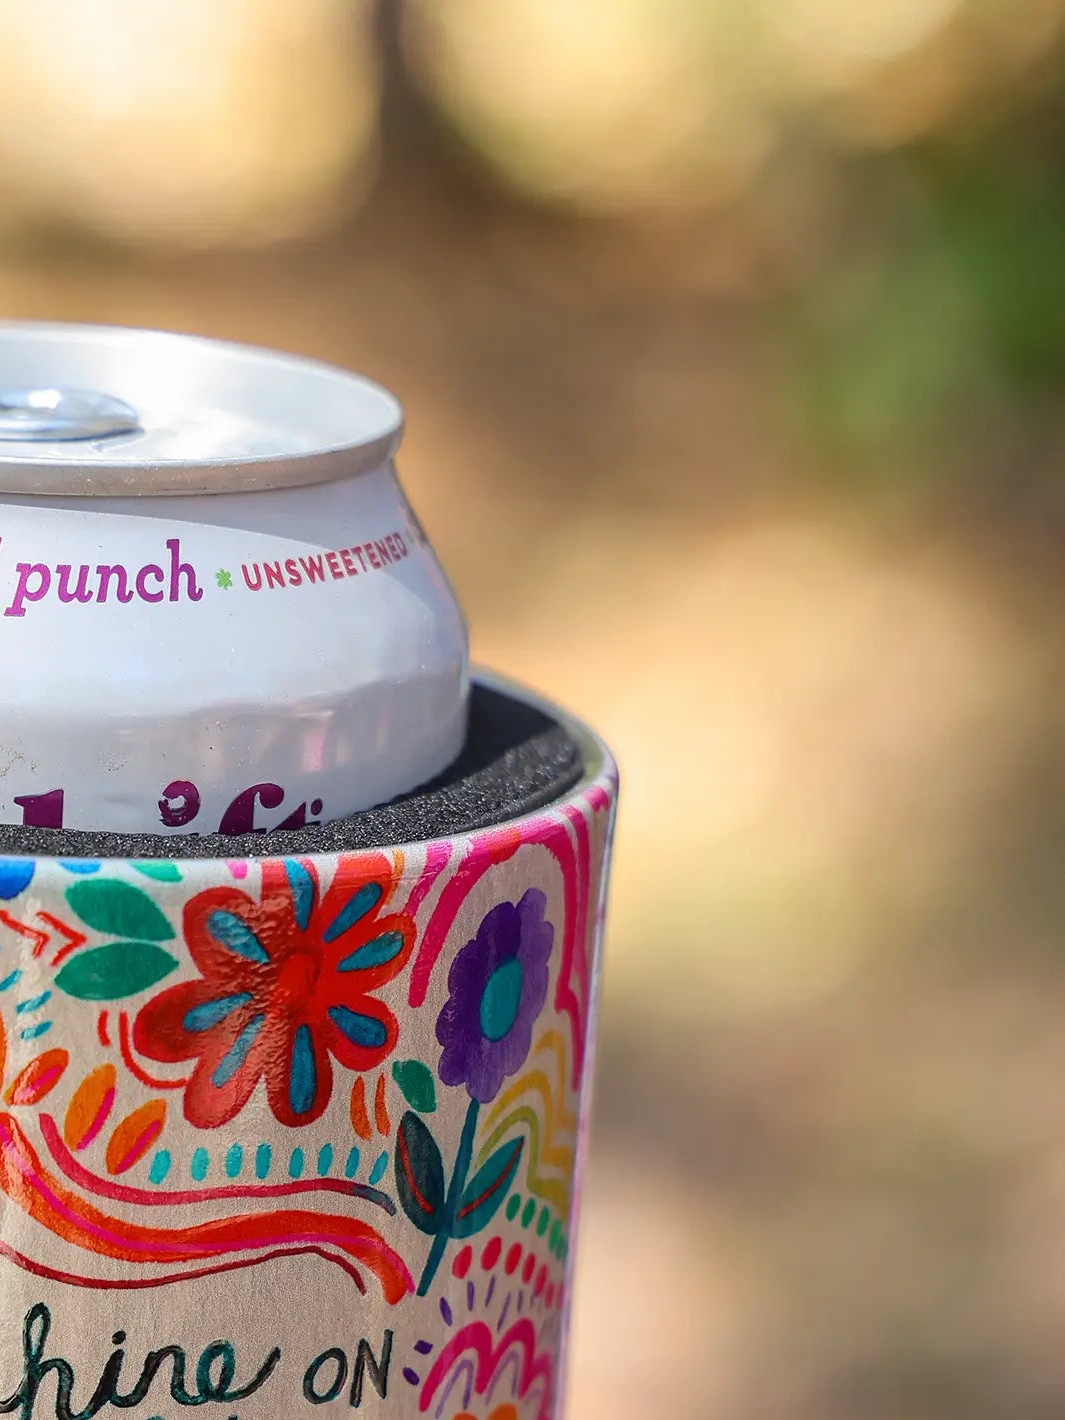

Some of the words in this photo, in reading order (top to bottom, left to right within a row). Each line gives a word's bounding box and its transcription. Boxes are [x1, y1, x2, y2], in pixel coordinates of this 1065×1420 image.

[3, 538, 203, 617] punch
[241, 532, 409, 592] UNSWEETENED
[302, 1329, 394, 1409] ON
